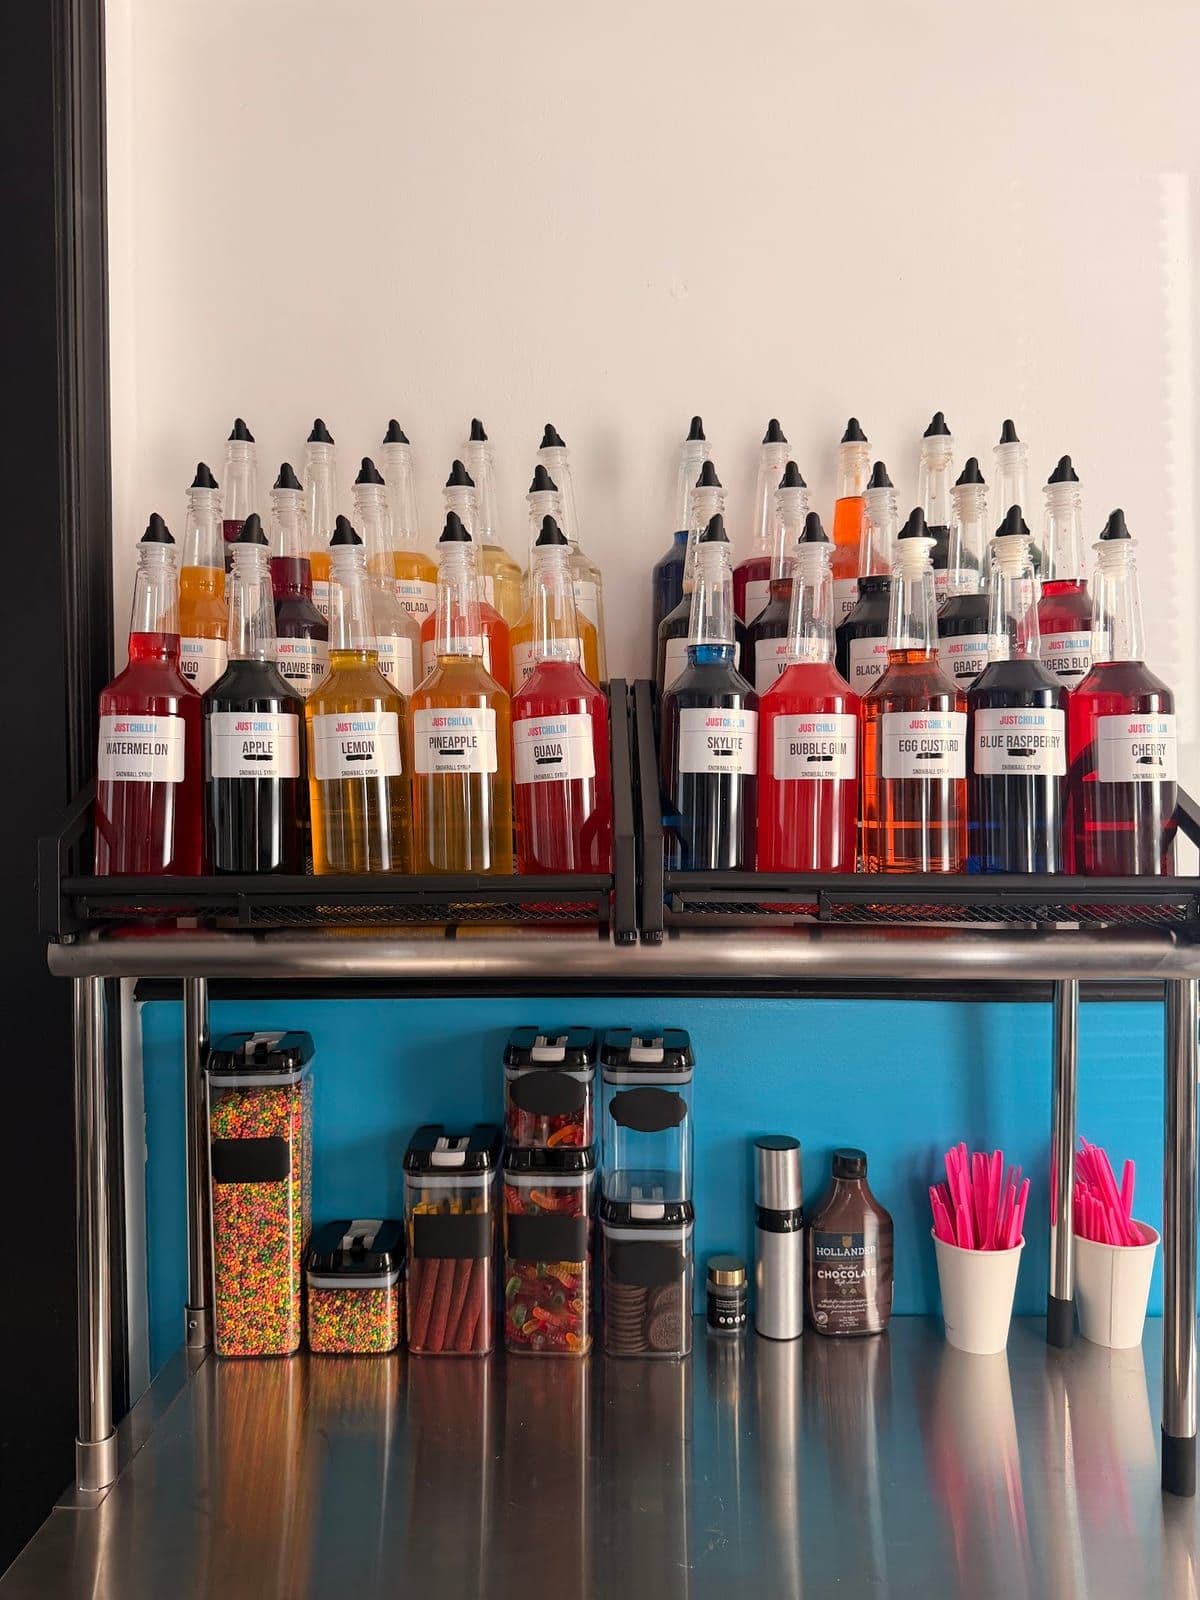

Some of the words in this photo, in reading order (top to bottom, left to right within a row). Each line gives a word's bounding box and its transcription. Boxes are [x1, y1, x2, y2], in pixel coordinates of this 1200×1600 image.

[181, 661, 199, 673] NGO
[855, 665, 881, 676] BLACK
[953, 660, 983, 673] GRAPE
[242, 741, 273, 753] APPLE
[341, 740, 375, 754] LEMON
[429, 736, 477, 748] PINEAPPLE
[707, 736, 743, 750] SKYLITE
[899, 740, 918, 752] EGG
[921, 740, 958, 752] CUSTARD
[980, 735, 1004, 748] BLUE
[1007, 735, 1060, 748] RASPBERRY
[106, 742, 168, 755] WATERMELON
[533, 743, 563, 758] GUAVA
[790, 743, 826, 755] BUBBLE
[829, 742, 847, 755] GUM
[1131, 743, 1166, 756] CHERRY
[817, 1267, 876, 1279] CHOCOLATE
